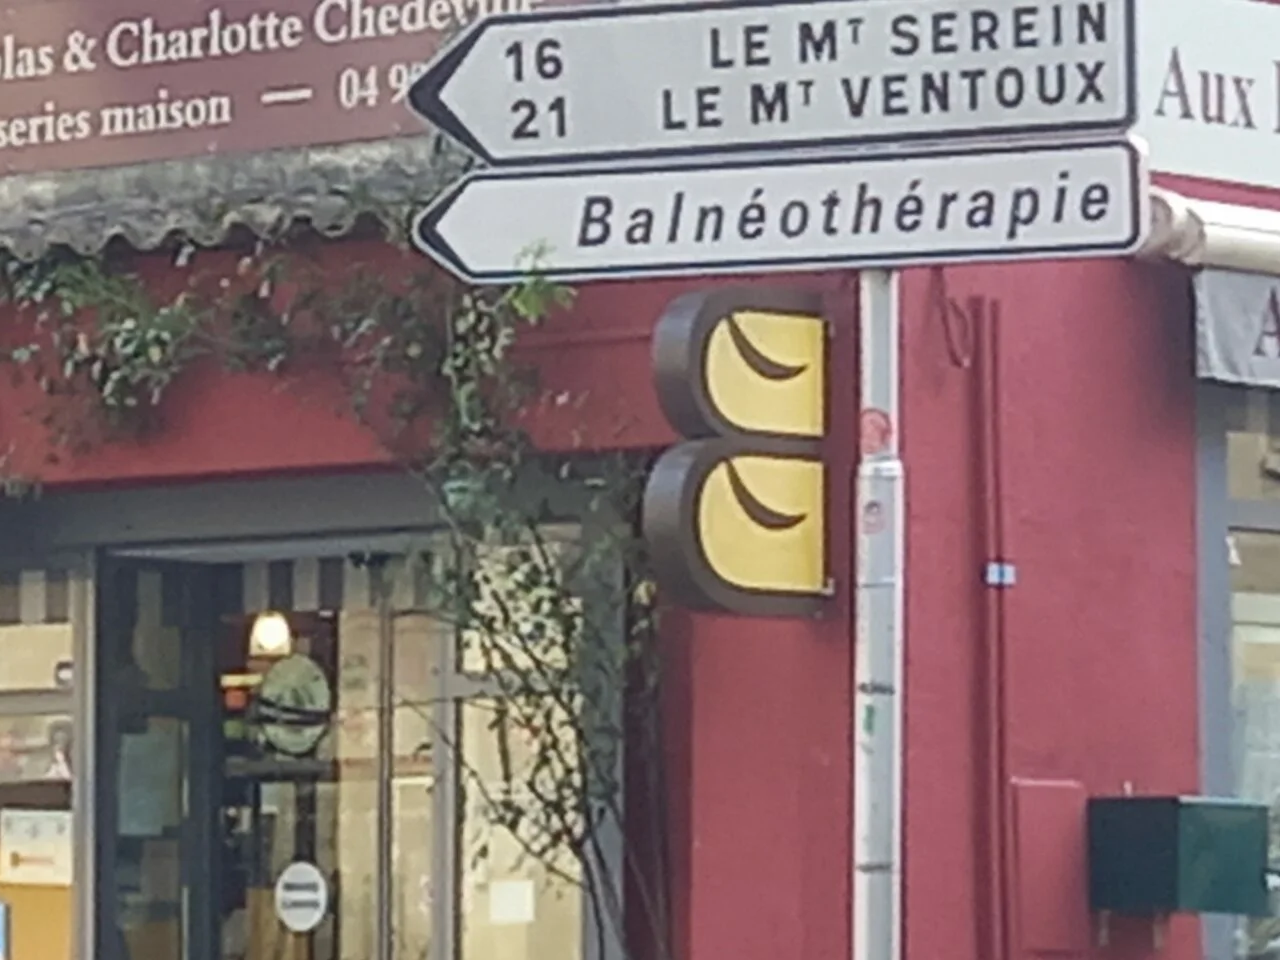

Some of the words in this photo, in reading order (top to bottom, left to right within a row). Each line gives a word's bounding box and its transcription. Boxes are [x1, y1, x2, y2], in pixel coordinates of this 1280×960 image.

[63, 30, 97, 72] &
[106, 8, 303, 66] Charlotte
[505, 38, 563, 82] 16
[710, 25, 771, 69] LE
[890, 1, 1107, 56] SEREIN
[100, 88, 232, 135] maison
[339, 65, 379, 109] 04
[510, 96, 567, 139] 21
[662, 87, 723, 130] LE
[841, 61, 1106, 118] VENTOUX
[1154, 46, 1257, 129] Aux
[577, 172, 1111, 248] Balnéothérapie
